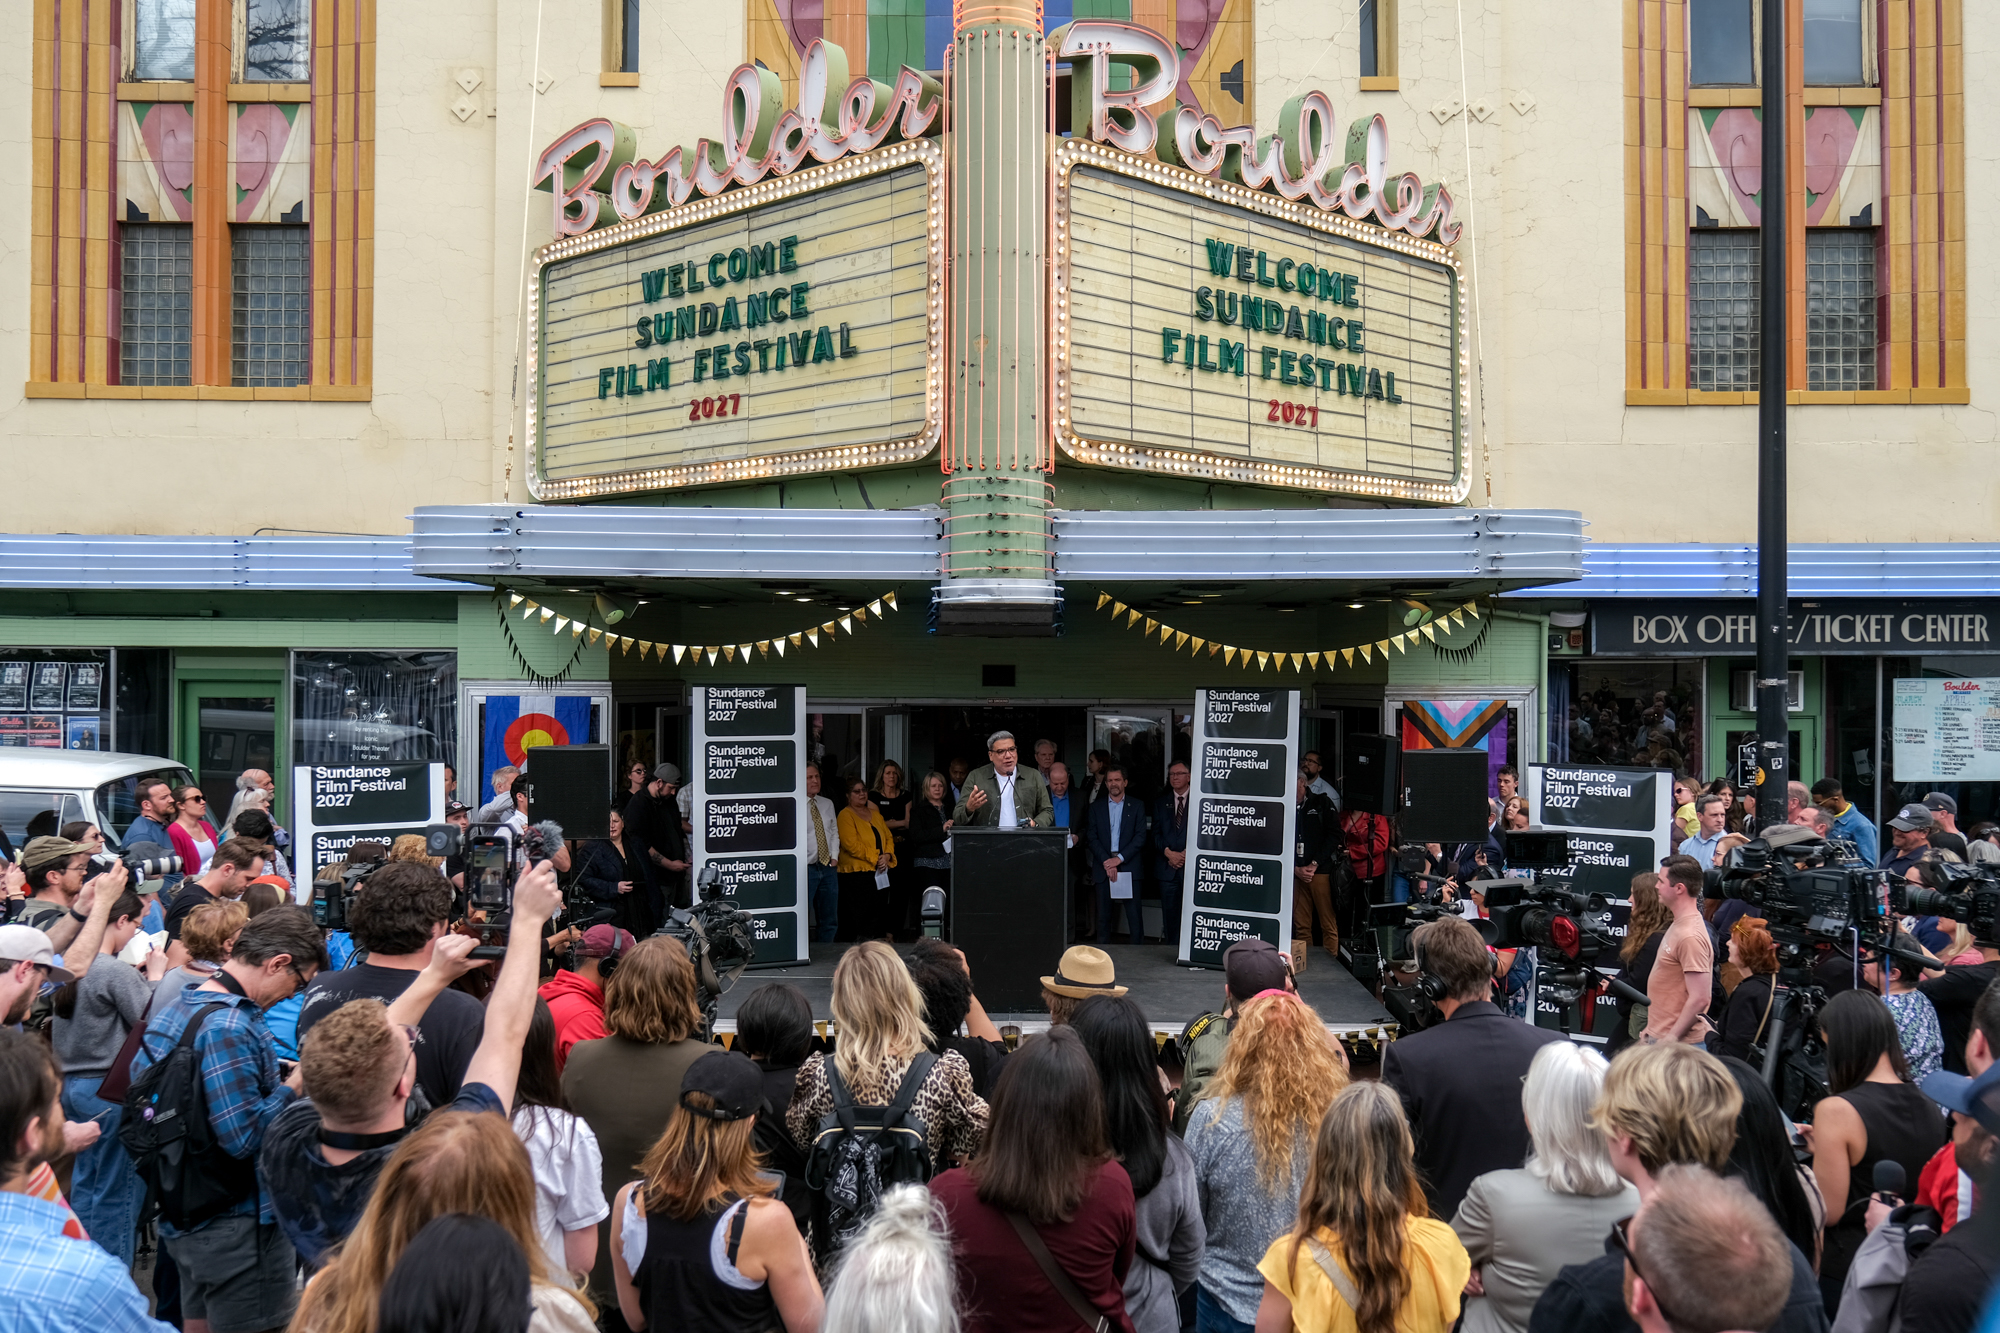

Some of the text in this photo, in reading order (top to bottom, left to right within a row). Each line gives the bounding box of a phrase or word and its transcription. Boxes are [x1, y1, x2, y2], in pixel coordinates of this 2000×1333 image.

[533, 37, 945, 240] Boulder
[1052, 19, 1463, 246] Boulder
[640, 235, 799, 304] WELCOME
[1205, 238, 1361, 309] WELCOME
[635, 281, 810, 349] SUNDANCE
[1195, 285, 1365, 353] SUNDANCE
[598, 322, 858, 400] FILM FESTIVAL
[1162, 327, 1403, 405] FILM FESTIVAL
[689, 393, 741, 421] 2027
[1267, 399, 1320, 427] 2027
[1633, 614, 1990, 643] BOX OFFIE/TICKET CENTER
[708, 687, 765, 698] Sundance
[1942, 681, 1980, 691] Boulder
[1208, 690, 1260, 701] Sundance
[708, 699, 777, 709] Film Festival
[1208, 701, 1271, 712] Film Festival
[708, 711, 737, 721] 2027
[1207, 713, 1234, 723] 2027
[709, 745, 765, 756] Sundance
[1206, 746, 1258, 758] Sundance
[709, 756, 777, 767] Film Festival
[1205, 757, 1269, 770] Film Festival
[316, 765, 391, 779] Sundance
[709, 769, 737, 779] 2027
[1204, 769, 1231, 779] 2027
[1546, 767, 1616, 783] Sundance
[316, 778, 406, 793] Film Festival
[1545, 782, 1631, 798] Film Festival
[316, 794, 353, 807] 2027
[1545, 795, 1579, 808] 2027
[709, 803, 766, 814] Sundance
[1202, 801, 1255, 815] Sundance
[709, 813, 778, 826] Film Festival
[1202, 813, 1266, 827] Film Festival
[709, 826, 737, 838] 2027
[1201, 824, 1228, 836] 2027
[1567, 837, 1614, 852] dance
[316, 850, 348, 863] Film
[1574, 851, 1630, 867] Festival
[1199, 858, 1253, 872] Sundance
[735, 870, 778, 883] Festival
[1198, 870, 1263, 885] Film Festival
[1197, 881, 1225, 893] 2027
[1195, 915, 1250, 931] Sundance
[755, 928, 779, 940] tival
[1195, 927, 1218, 939] Film
[1193, 938, 1222, 951] 2027
[1189, 1018, 1209, 1040] Nikon
